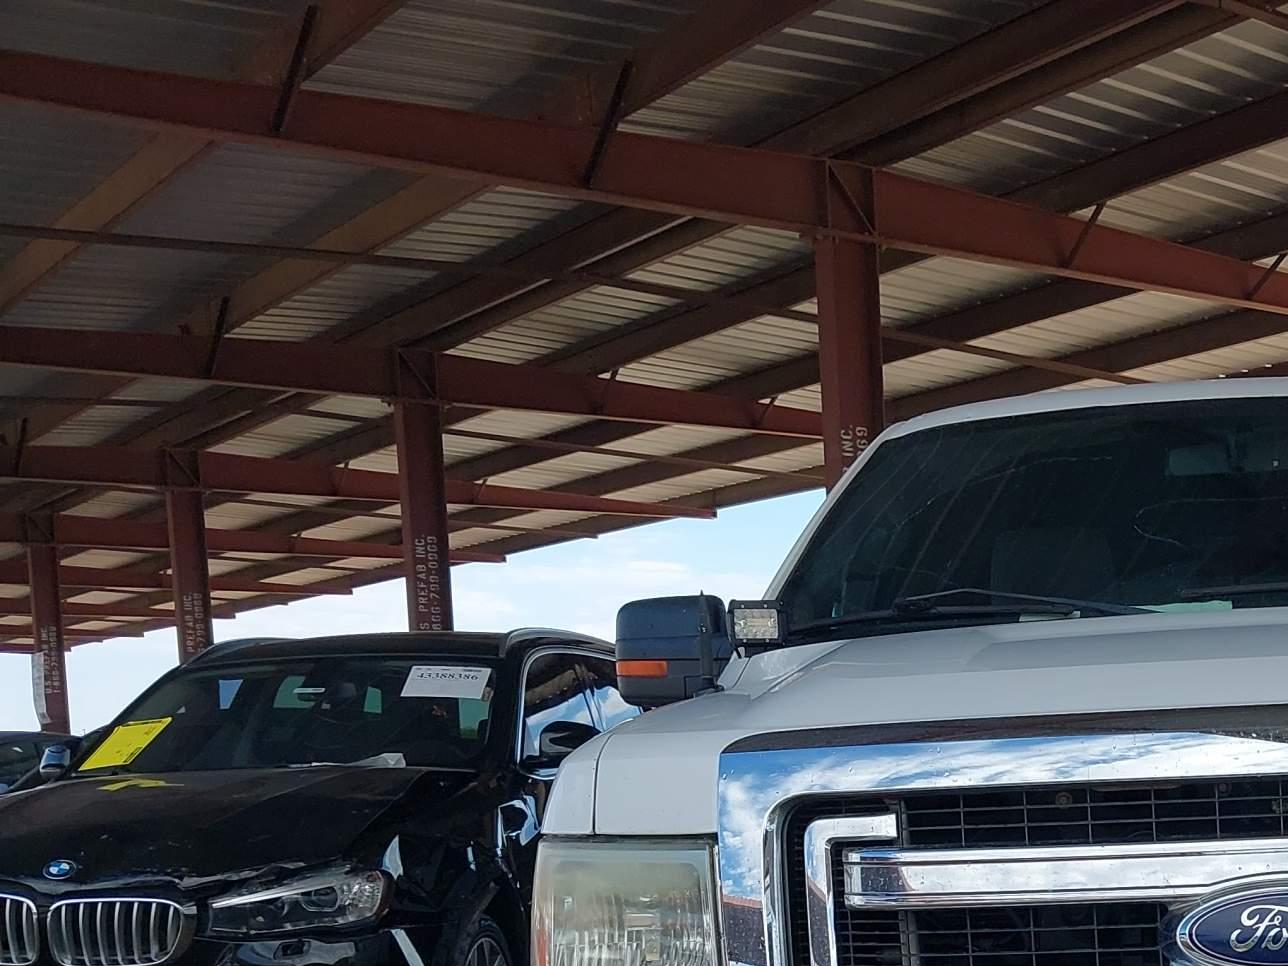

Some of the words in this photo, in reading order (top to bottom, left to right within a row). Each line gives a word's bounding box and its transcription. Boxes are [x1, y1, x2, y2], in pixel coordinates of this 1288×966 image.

[840, 425, 855, 457] INC.
[416, 564, 429, 612] PREFAB
[416, 672, 479, 681] 43388386
